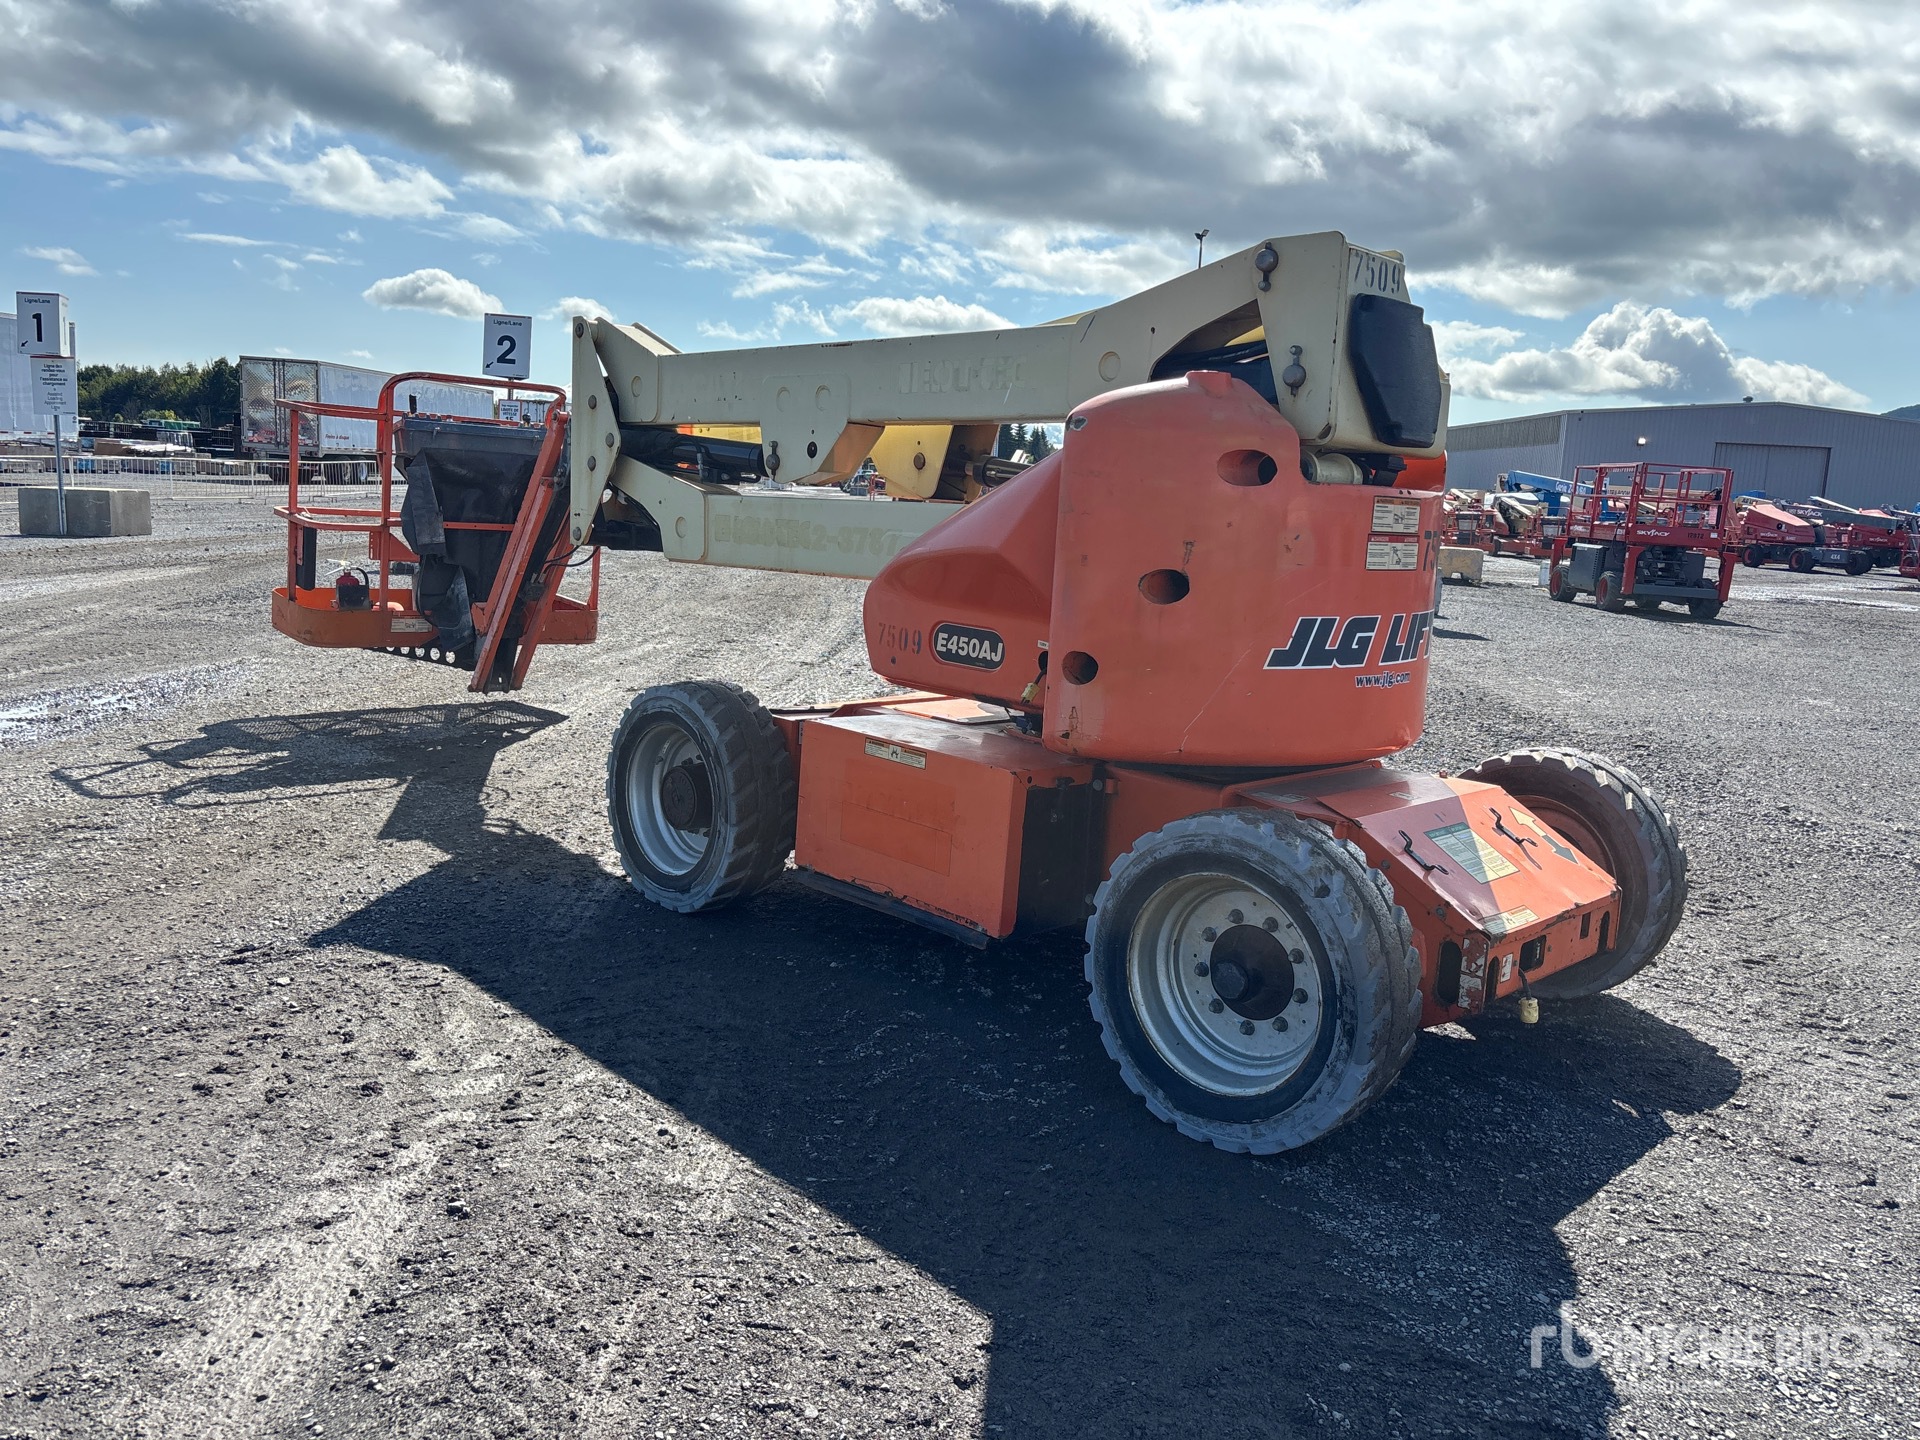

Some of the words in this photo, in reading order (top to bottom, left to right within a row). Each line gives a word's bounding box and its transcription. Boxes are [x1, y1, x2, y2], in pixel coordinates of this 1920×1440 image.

[1354, 250, 1402, 294] 7509
[32, 312, 43, 342] 1
[493, 319, 523, 327] Ligne/Lane
[496, 335, 517, 365] 2
[878, 622, 922, 655] 7509
[935, 632, 1004, 662] E450AJ
[1263, 615, 1382, 670] JLG
[1355, 670, 1411, 690] www.jlg.com
